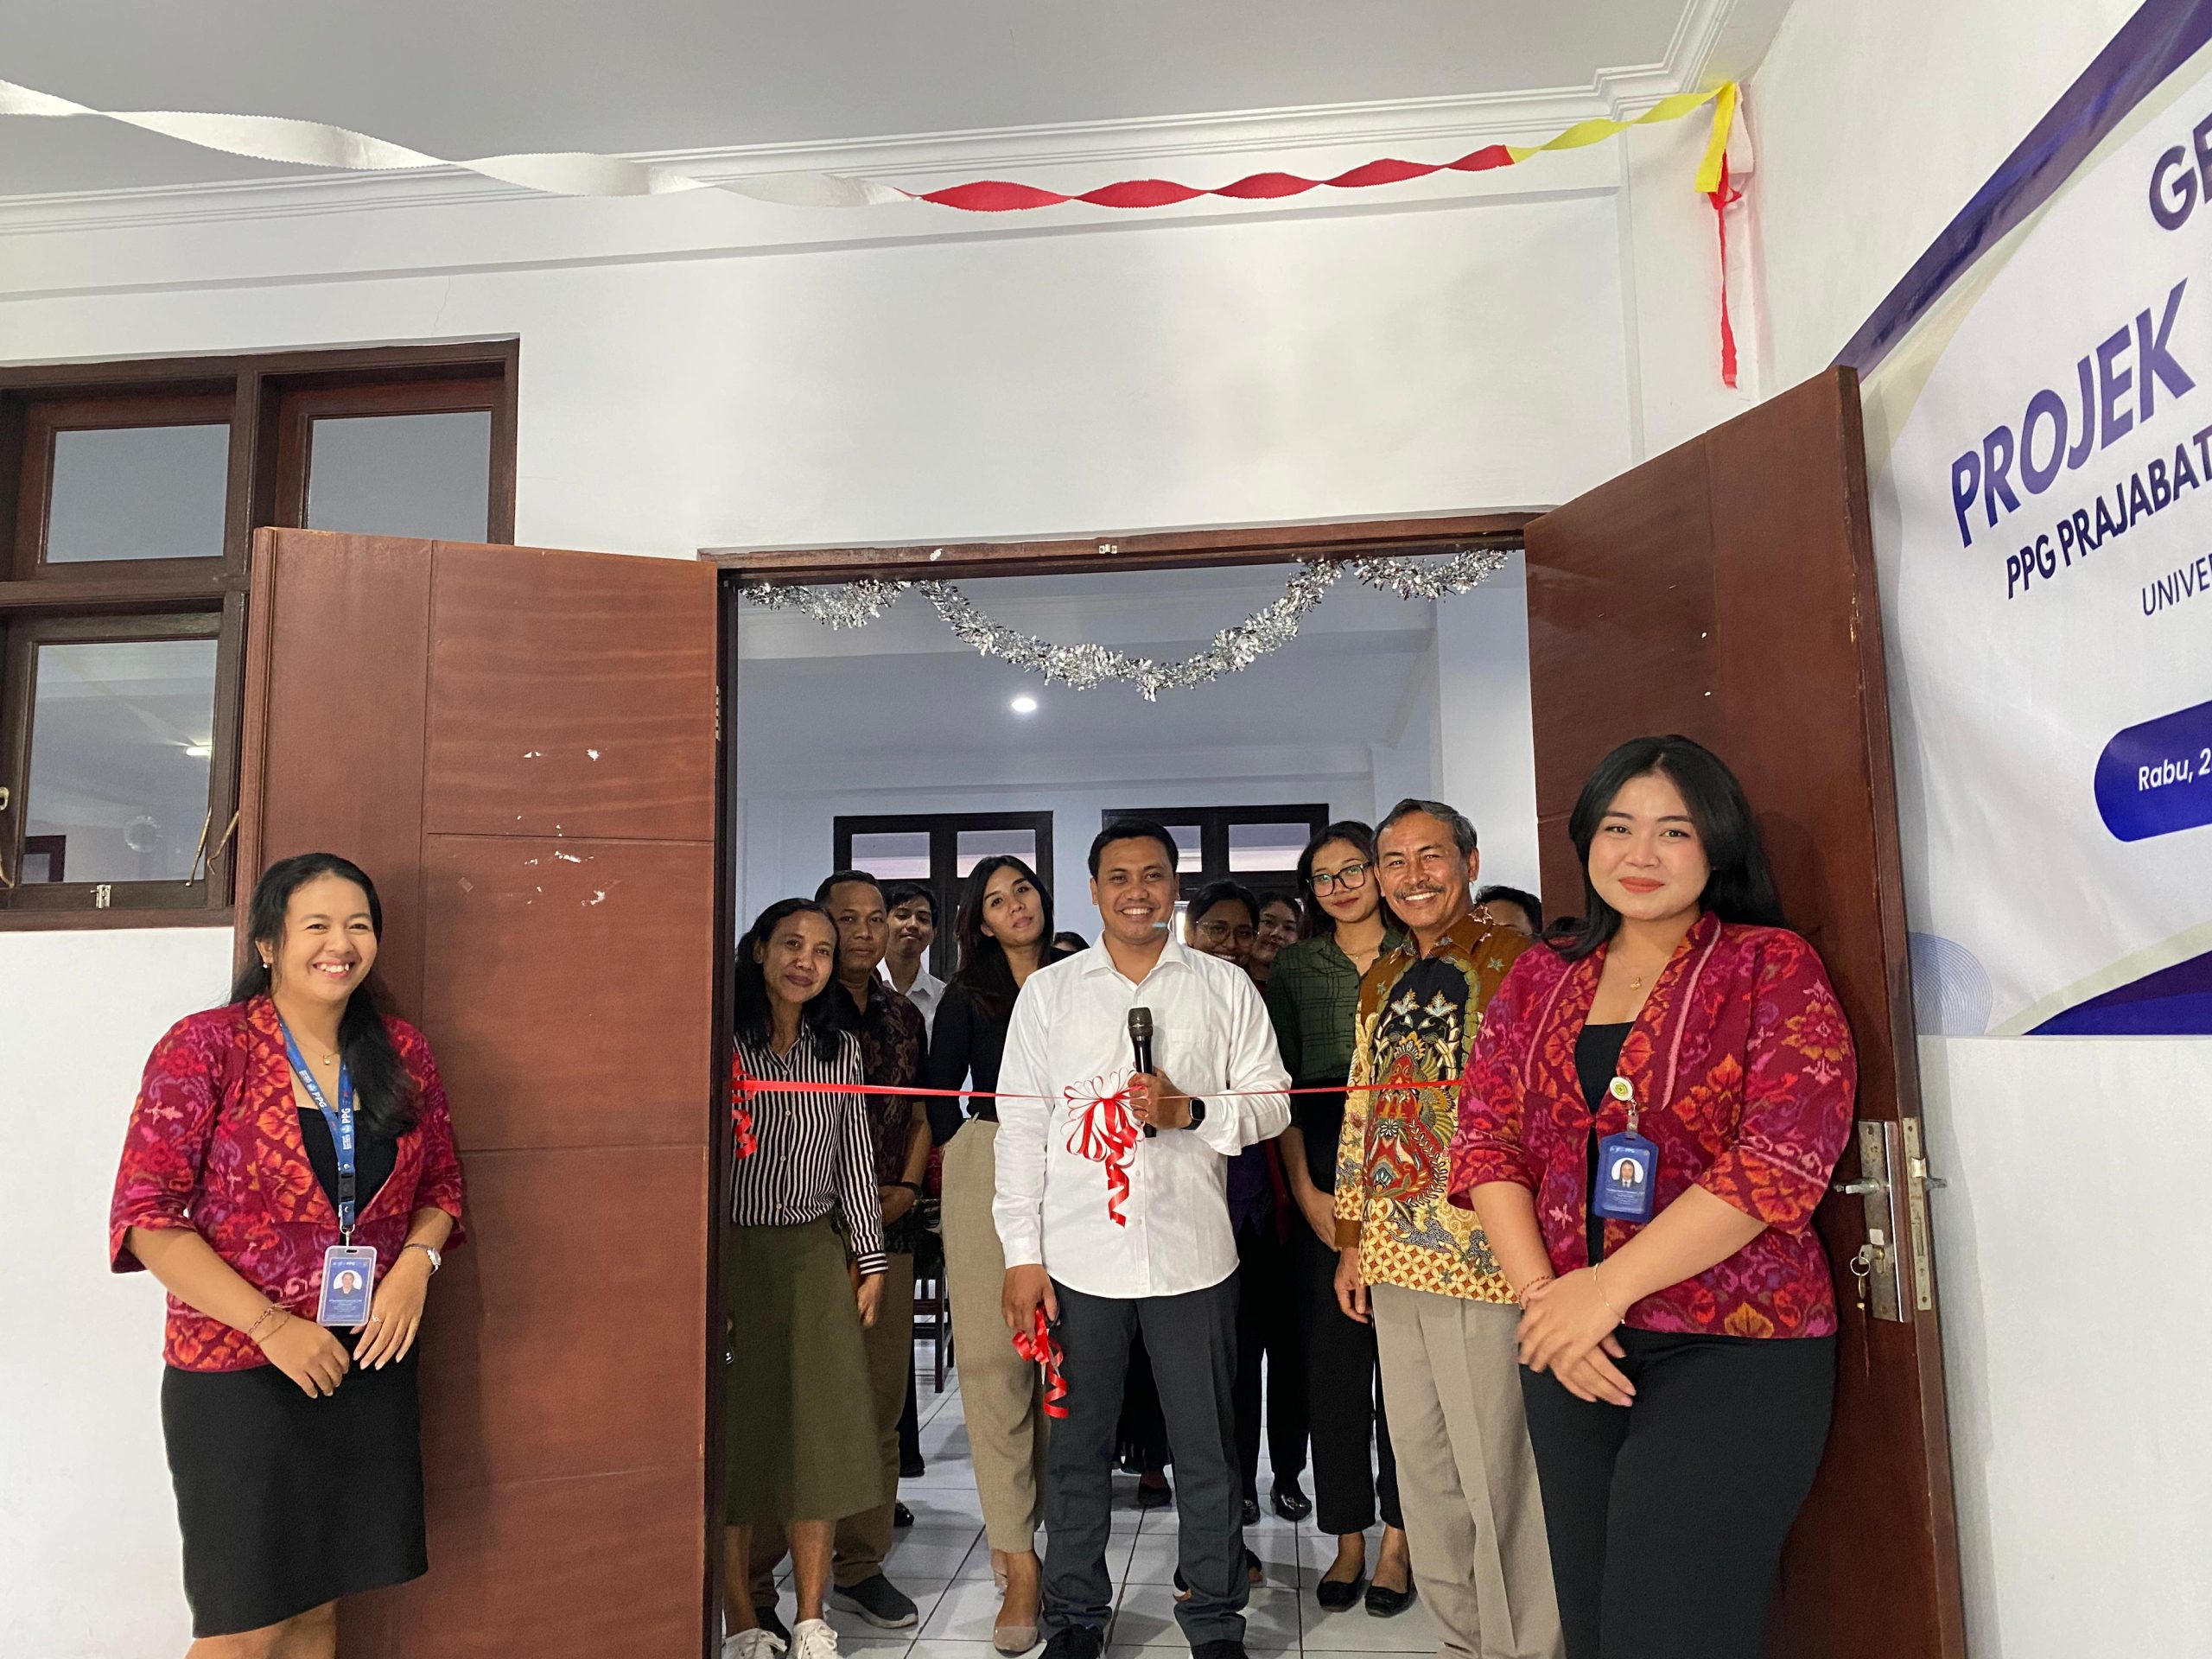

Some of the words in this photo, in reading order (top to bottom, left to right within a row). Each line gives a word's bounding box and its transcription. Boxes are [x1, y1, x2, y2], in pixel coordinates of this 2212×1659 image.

[1951, 277, 2196, 549] PROJEK
[2006, 533, 2056, 601] PPG
[2142, 553, 2212, 616] UNIVE
[2139, 759, 2194, 791] Rabu,
[311, 1091, 327, 1108] PPG
[341, 1108, 351, 1124] PPG
